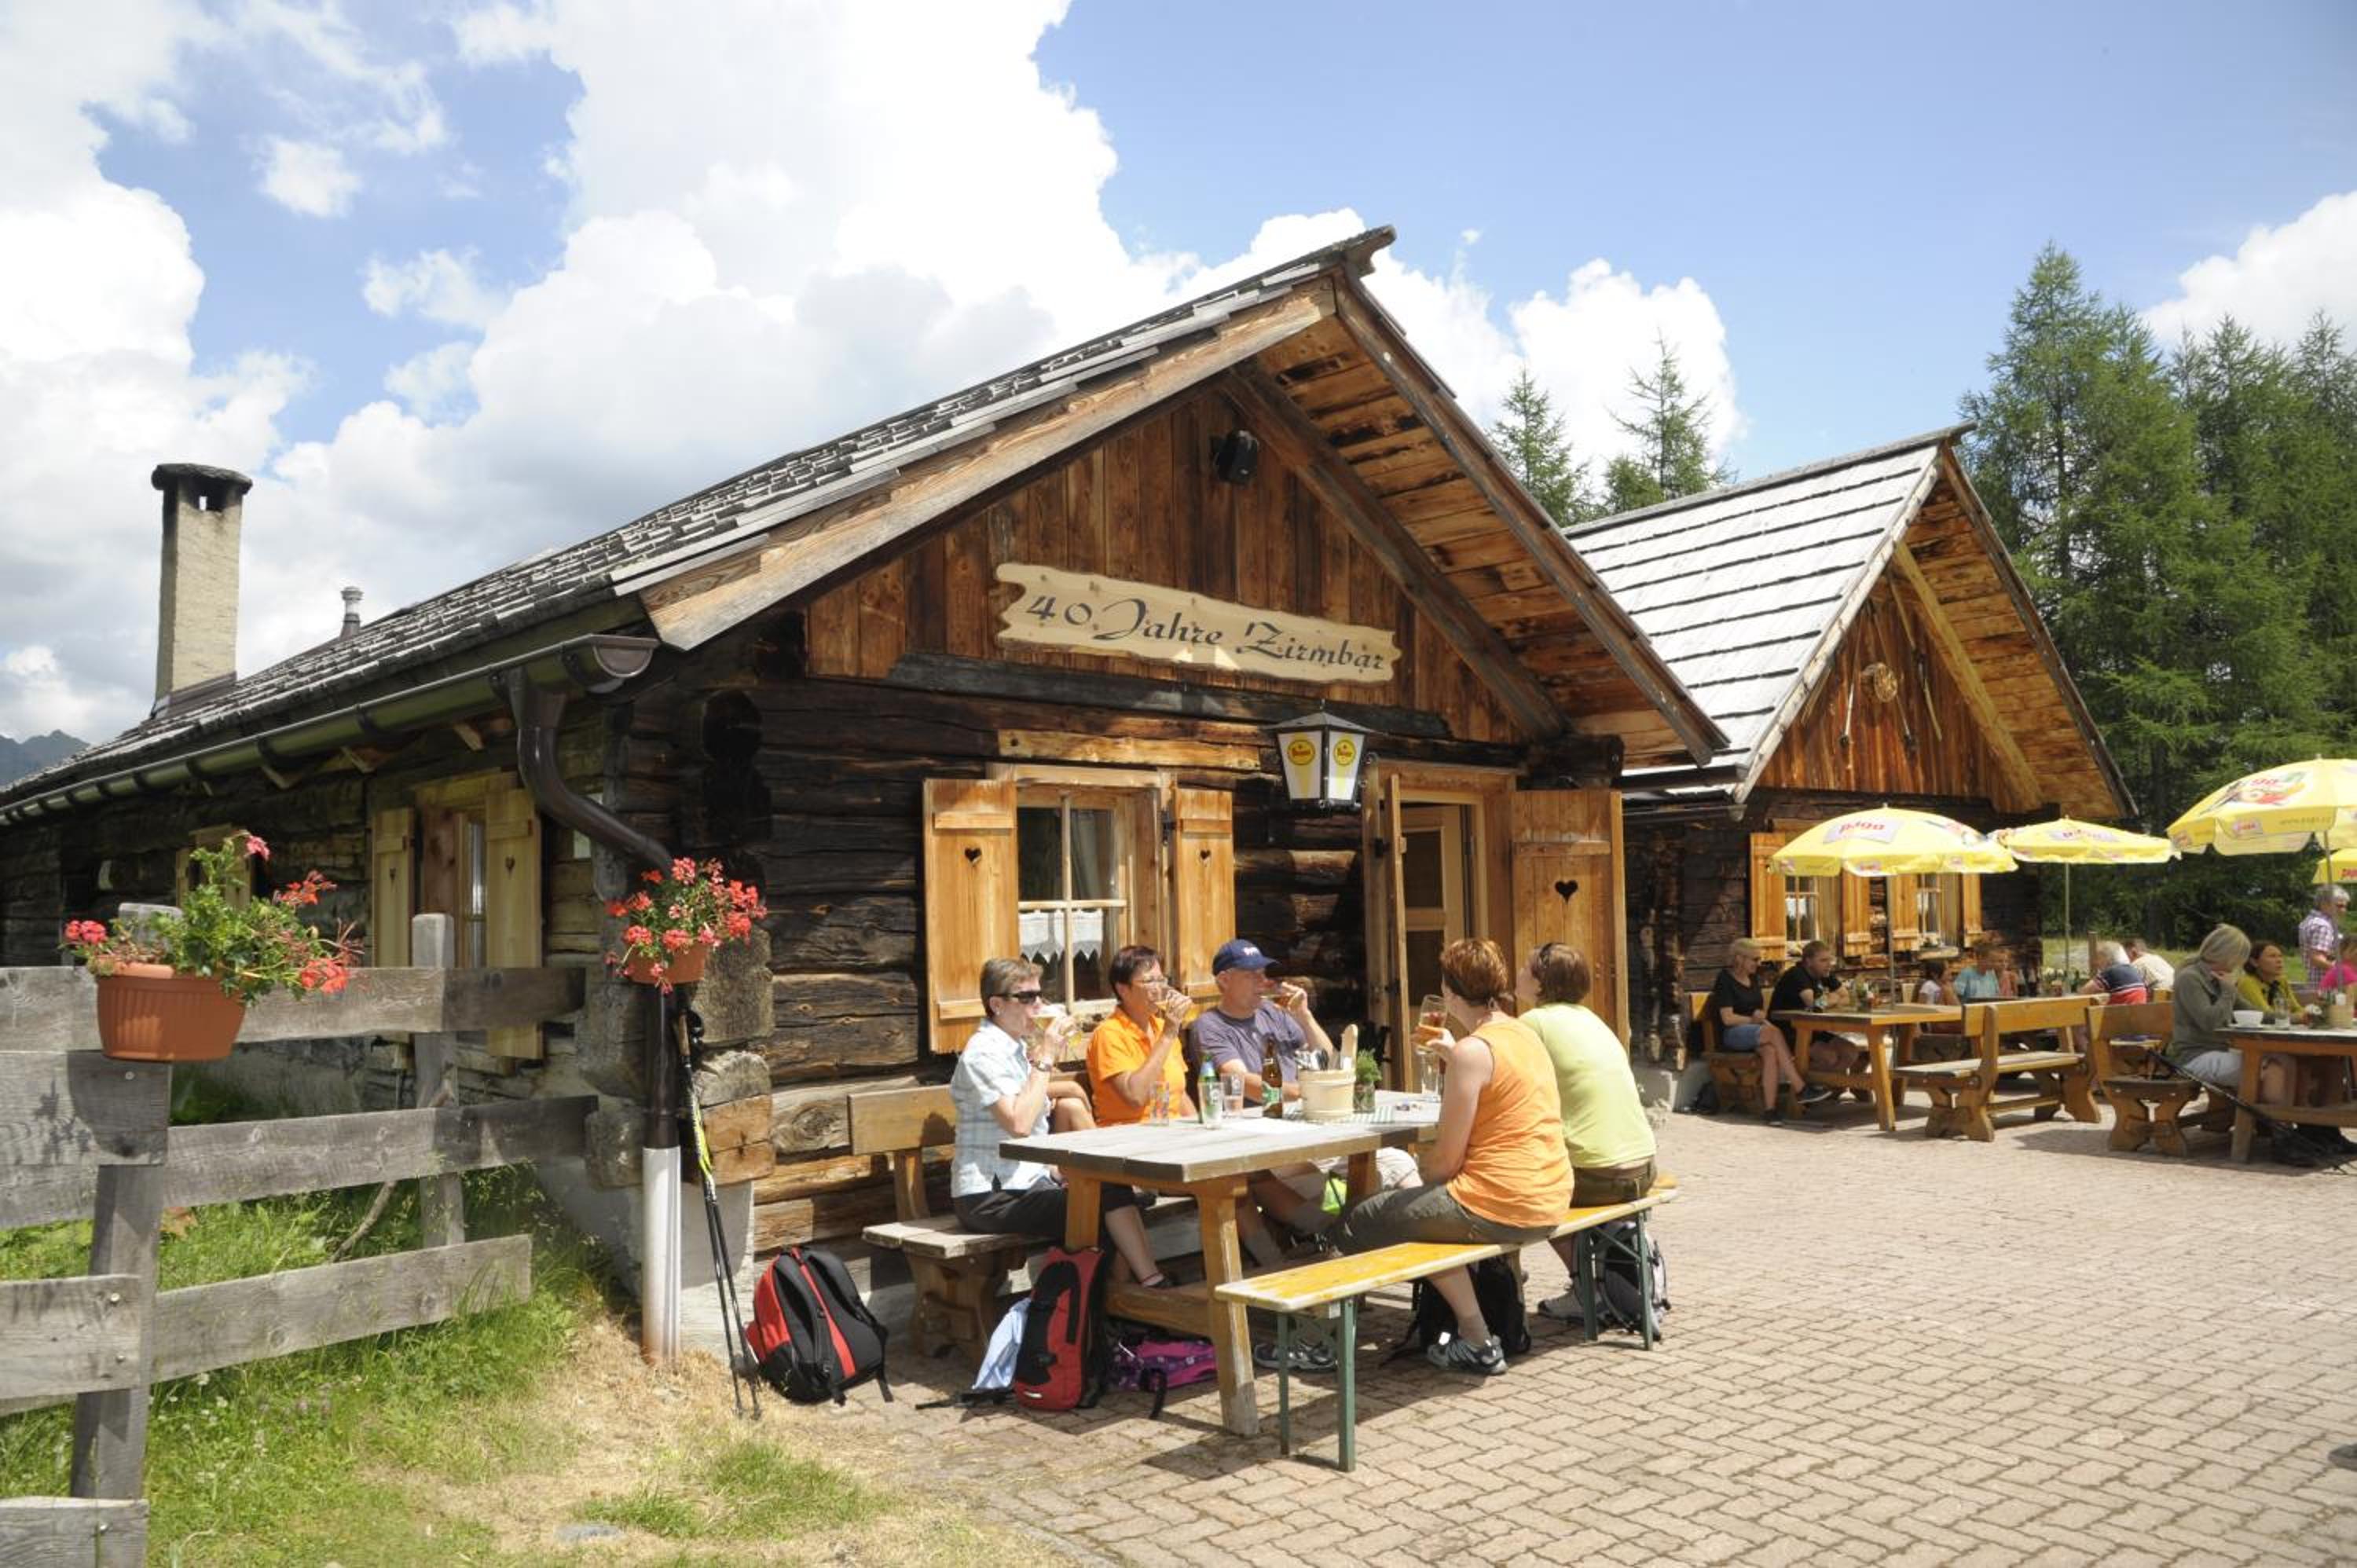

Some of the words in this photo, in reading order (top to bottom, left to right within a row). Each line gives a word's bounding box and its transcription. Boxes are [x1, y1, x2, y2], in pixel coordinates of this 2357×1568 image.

[1026, 595, 1092, 626] 40
[1093, 598, 1223, 646] Jahre
[1236, 621, 1384, 670] Zirmbar
